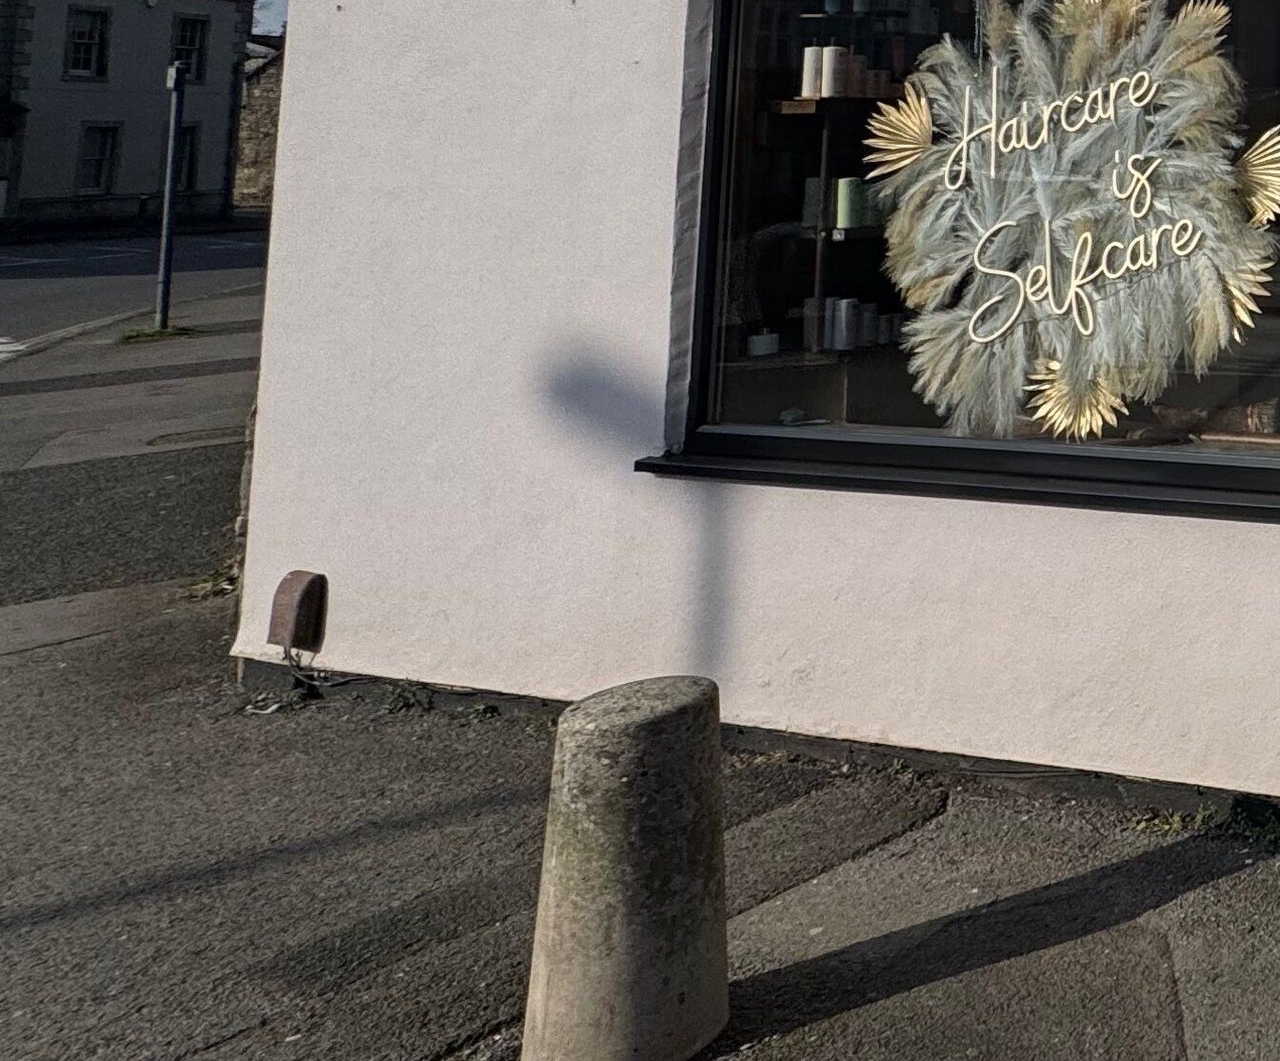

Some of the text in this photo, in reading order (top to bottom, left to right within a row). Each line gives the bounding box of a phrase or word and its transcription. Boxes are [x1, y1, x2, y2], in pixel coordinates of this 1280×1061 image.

[944, 65, 1159, 190] Haircare
[1113, 151, 1162, 219] is
[968, 218, 1202, 343] Selfcare
